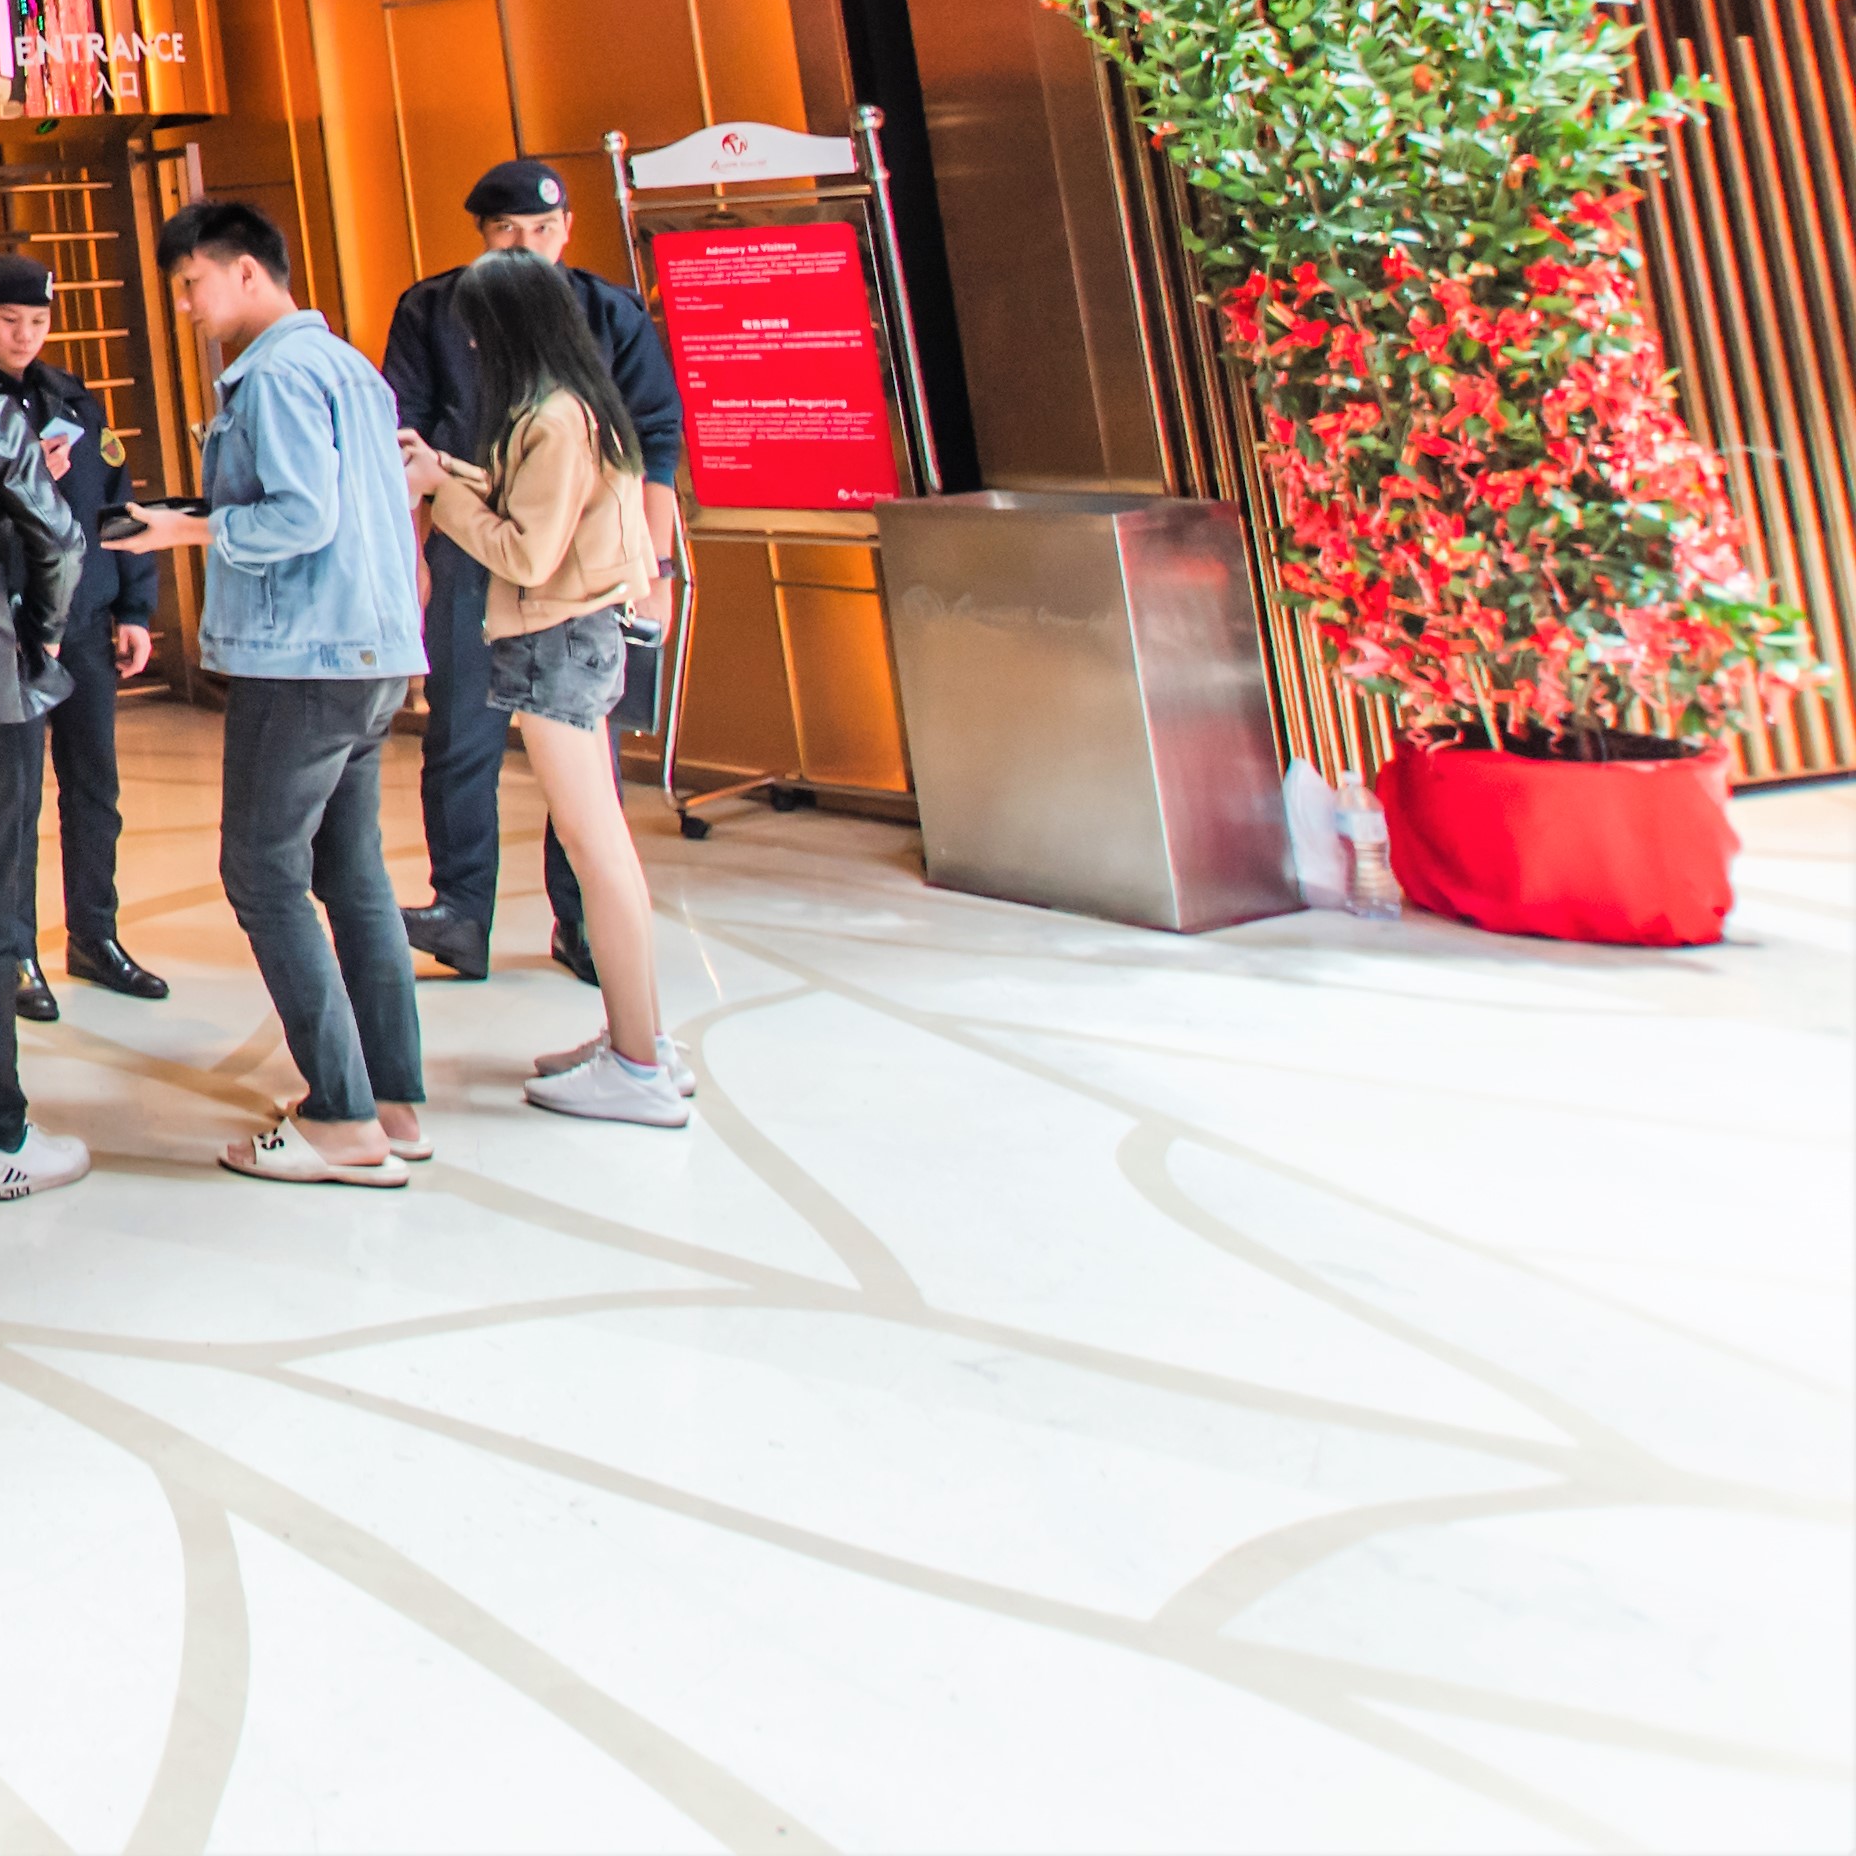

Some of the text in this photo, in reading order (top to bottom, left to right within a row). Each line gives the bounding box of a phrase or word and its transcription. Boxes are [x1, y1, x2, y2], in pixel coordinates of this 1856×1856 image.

[14, 32, 186, 67] ENTRANCE
[92, 70, 139, 99] 入口
[748, 245, 760, 254] to
